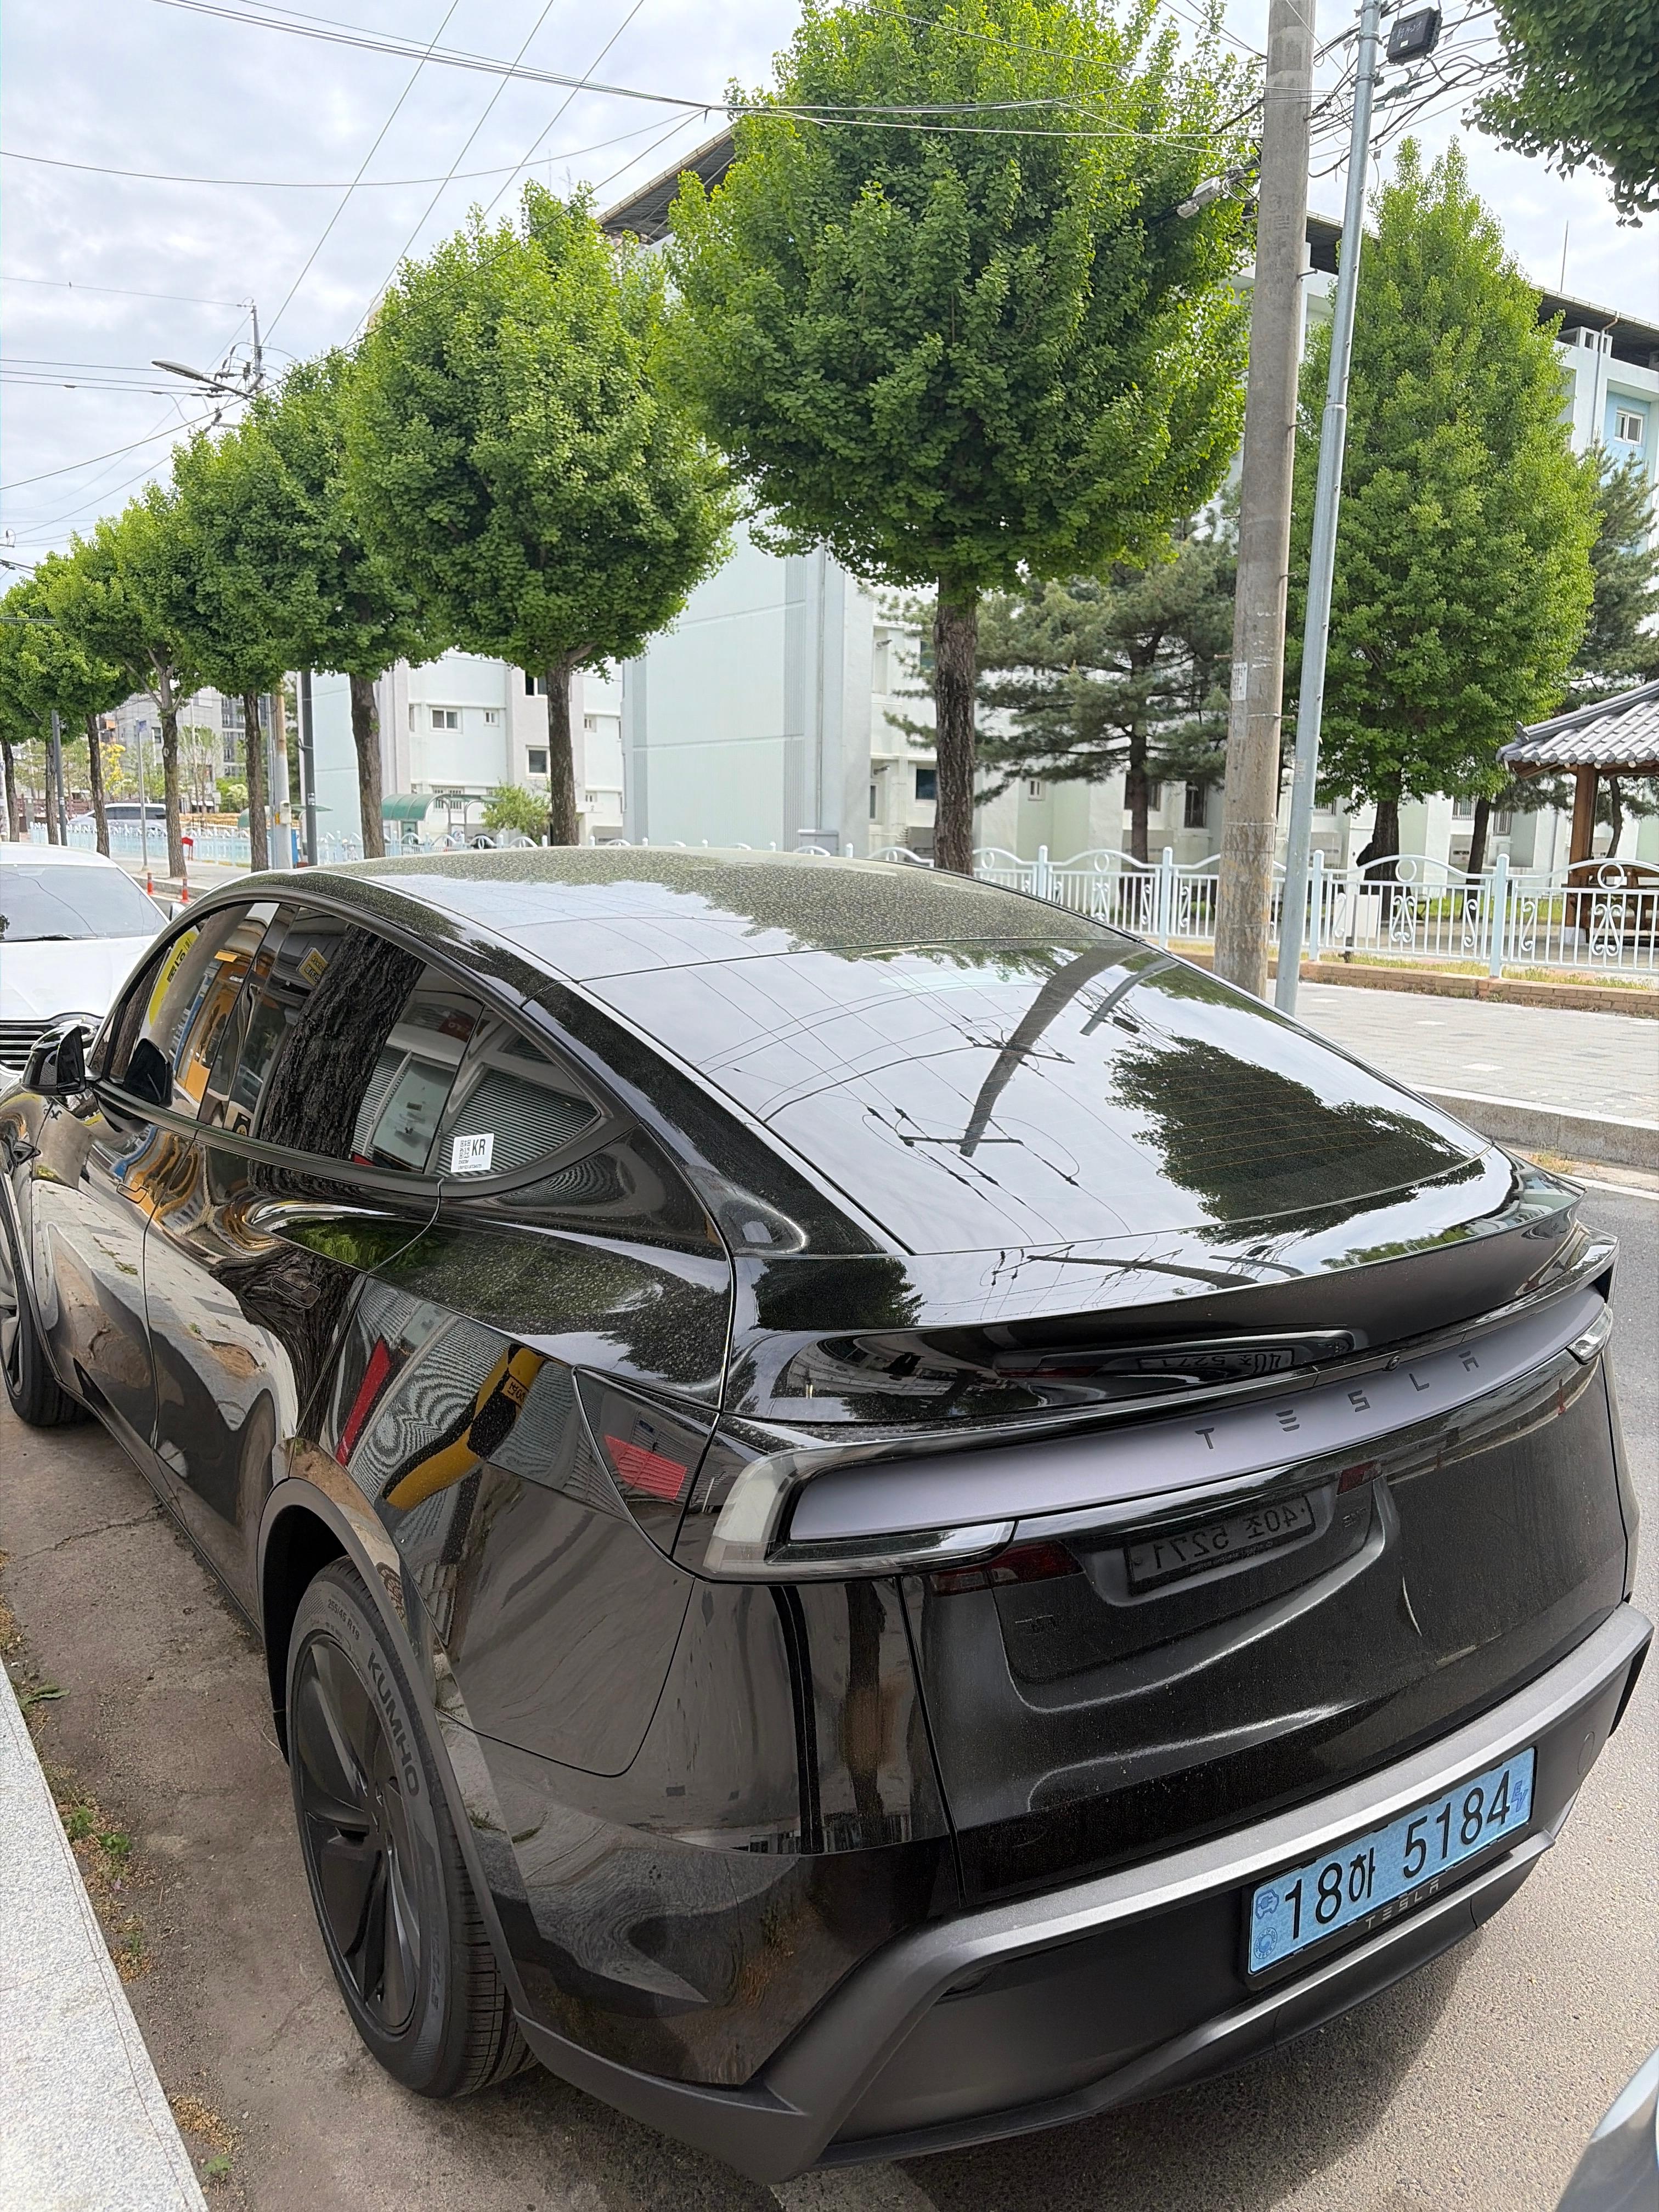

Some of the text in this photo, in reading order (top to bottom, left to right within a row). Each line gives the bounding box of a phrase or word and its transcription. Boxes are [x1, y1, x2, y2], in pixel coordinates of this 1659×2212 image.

[472, 1138, 486, 1156] KR
[1195, 1351, 1480, 1449] TESLA
[347, 1618, 360, 1640] R19
[368, 1650, 420, 1797] KUMHO
[1511, 1780, 1529, 1813] EV
[1285, 1769, 1510, 1940] 18하 5184
[1365, 1878, 1440, 1929] TESLA
